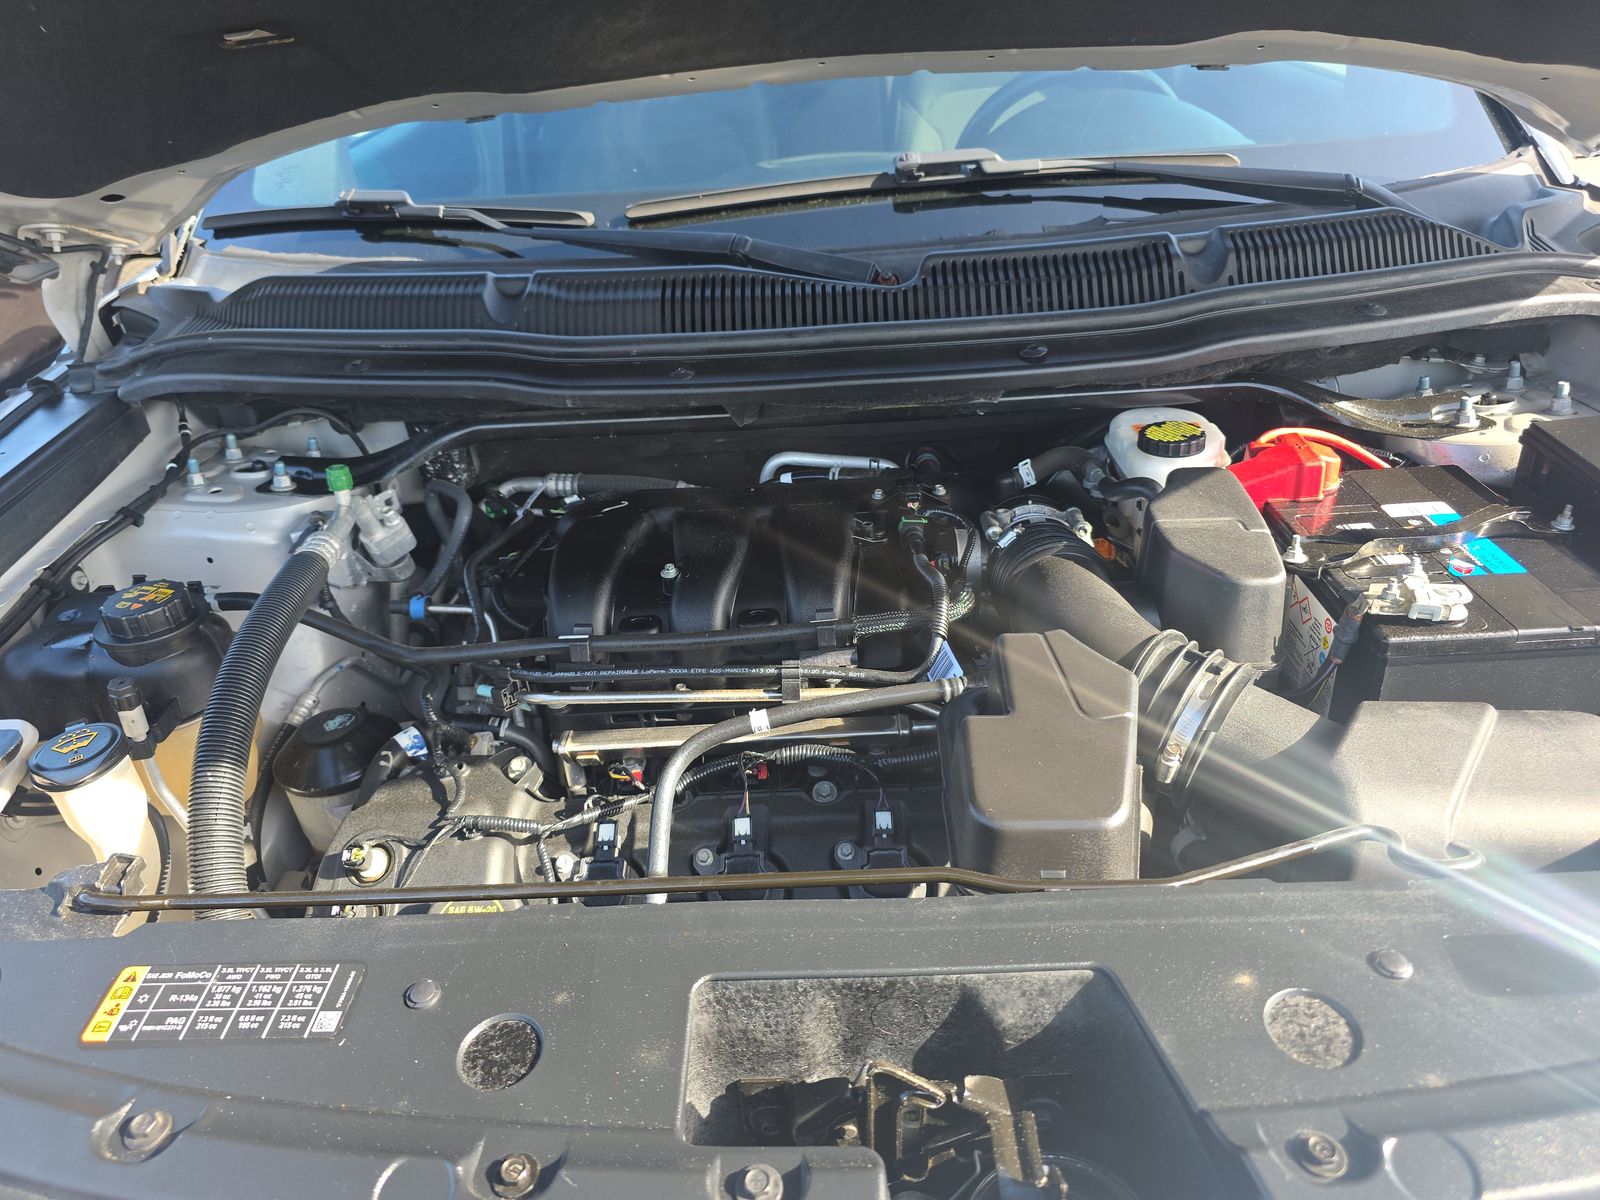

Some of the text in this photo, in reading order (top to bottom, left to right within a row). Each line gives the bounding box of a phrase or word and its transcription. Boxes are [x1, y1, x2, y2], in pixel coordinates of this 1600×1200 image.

[448, 905, 466, 914] SAE
[175, 971, 213, 980] FoMoCo
[231, 985, 242, 994] kg
[272, 985, 283, 994] kg
[312, 985, 323, 994] kg
[168, 994, 199, 1002] R-134a
[165, 1016, 187, 1025] PAG
